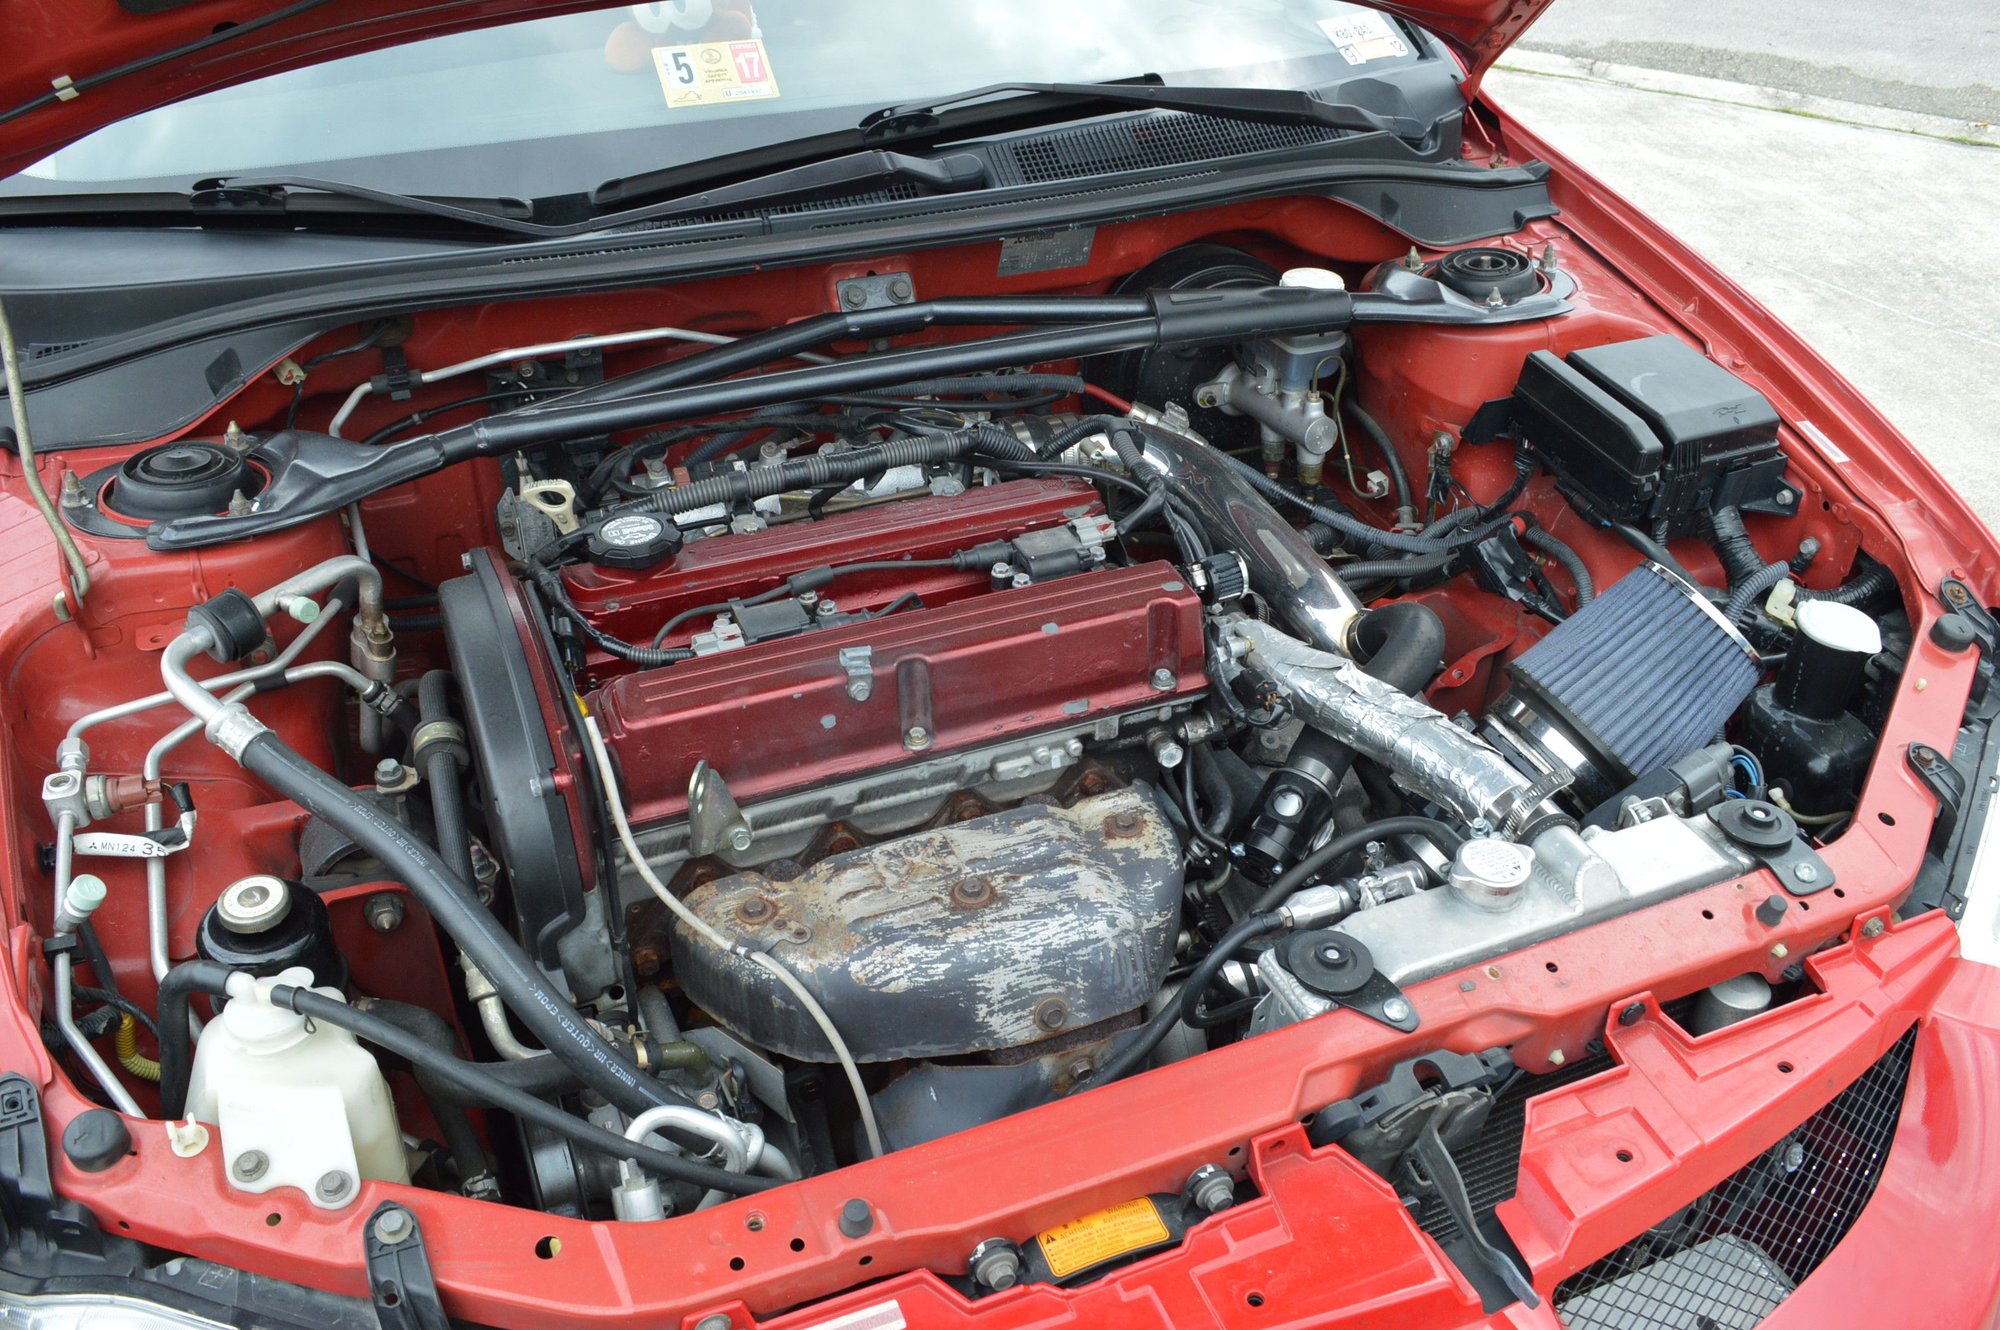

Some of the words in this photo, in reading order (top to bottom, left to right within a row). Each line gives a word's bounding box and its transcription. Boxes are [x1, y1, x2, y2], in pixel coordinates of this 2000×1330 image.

[1389, 40, 1406, 53] 12
[671, 51, 694, 84] 5
[735, 51, 761, 80] 17
[100, 842, 136, 853] MN124
[1105, 1200, 1140, 1214] WARNING
[1058, 1223, 1095, 1241] ACHTUNG
